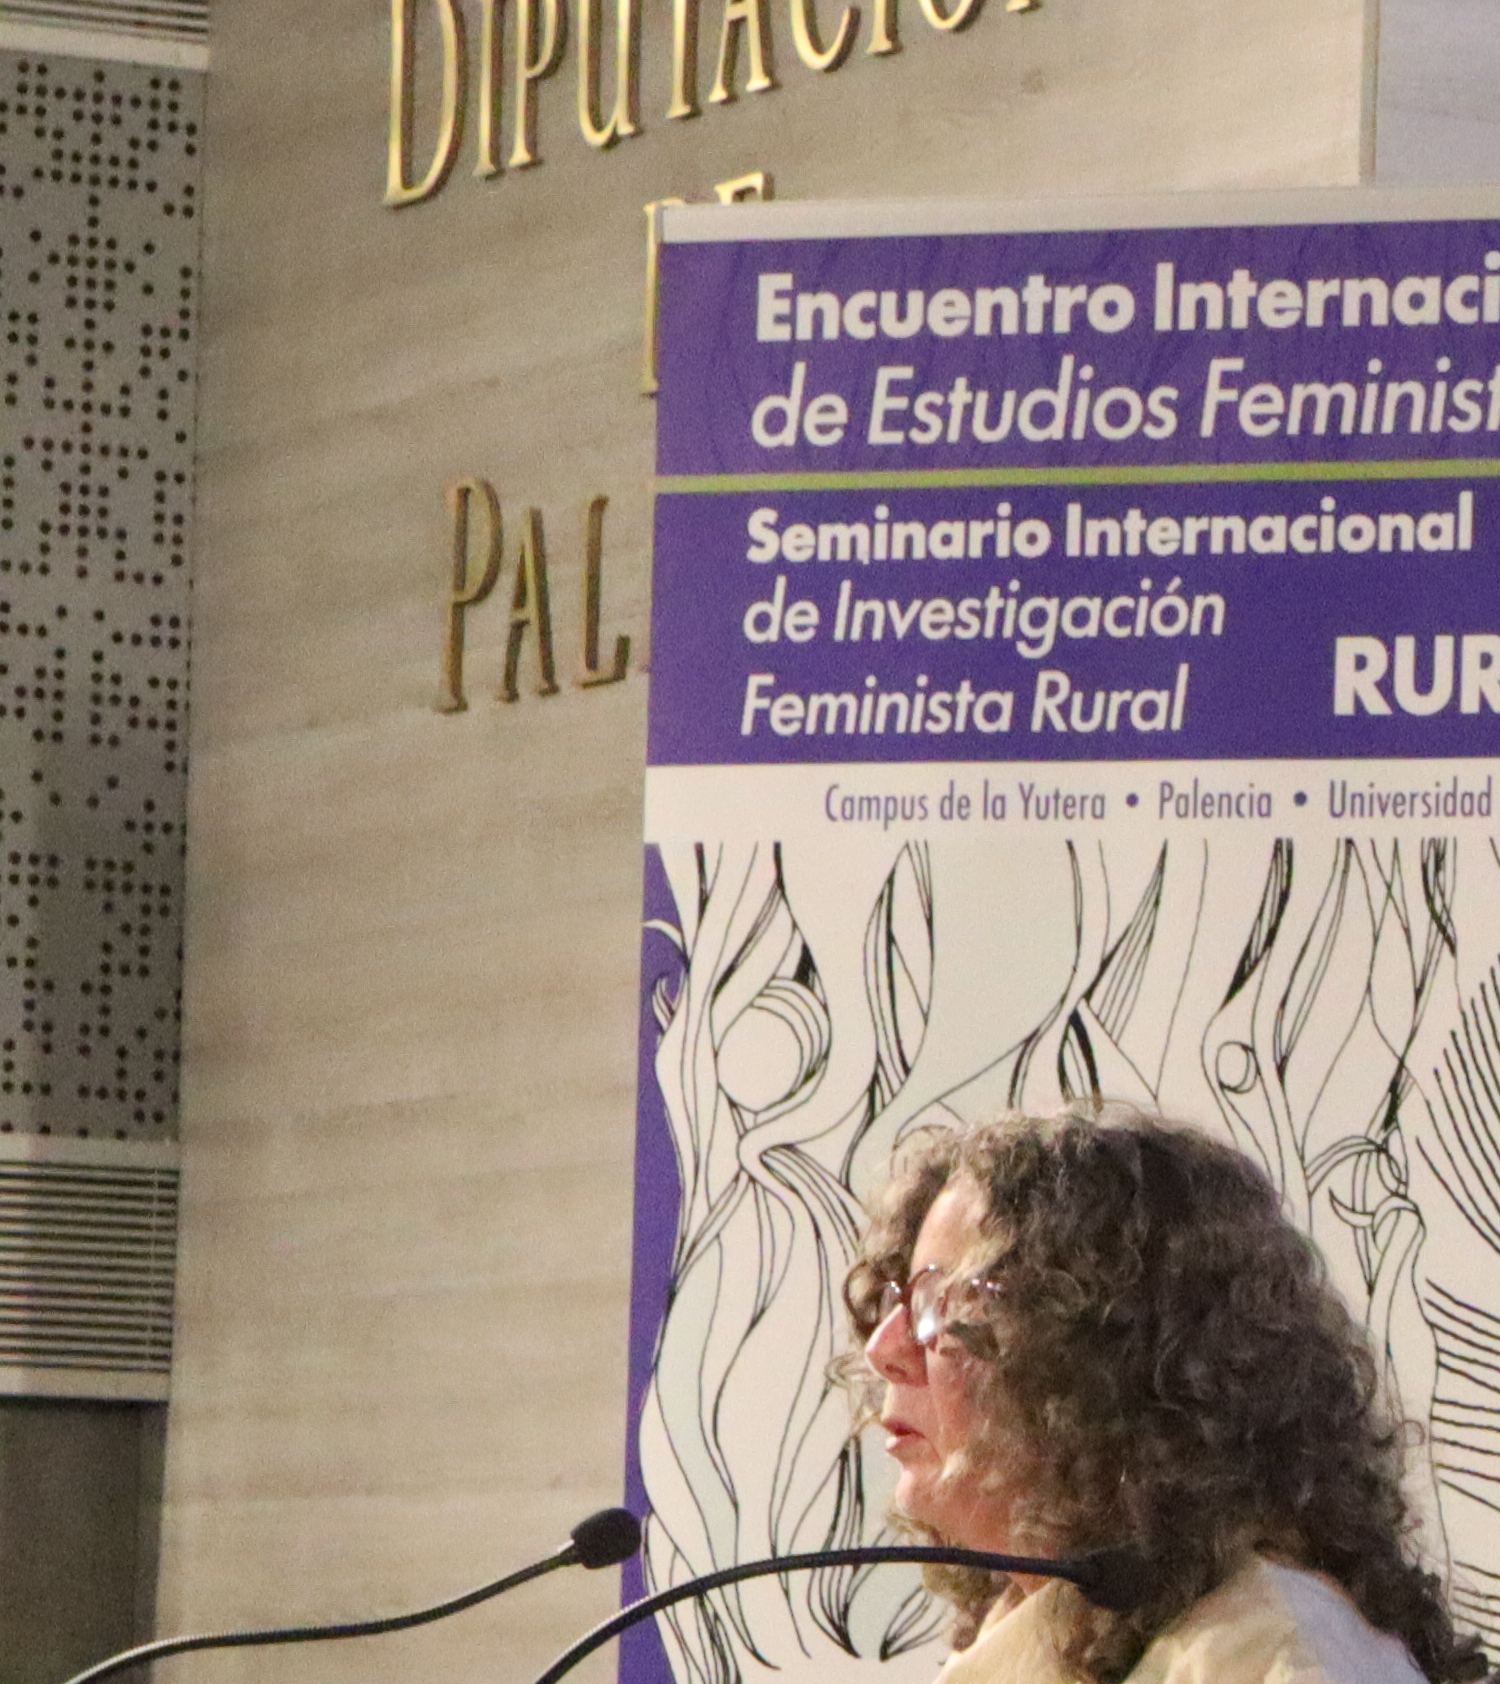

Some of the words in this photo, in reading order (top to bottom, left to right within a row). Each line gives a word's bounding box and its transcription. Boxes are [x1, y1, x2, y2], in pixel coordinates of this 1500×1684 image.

[384, 0, 1036, 207] DIPUTA
[756, 272, 1135, 342] Encuentro
[751, 361, 848, 449] de
[867, 354, 1179, 446] Estudios
[746, 502, 1052, 565] Seminario
[1065, 490, 1473, 557] Internacional
[434, 476, 634, 714] PAL
[742, 575, 820, 644] de
[832, 576, 1225, 660] Investigación
[740, 673, 1014, 737] Feminista
[1030, 662, 1189, 733] Rural
[824, 783, 929, 832] Campus
[938, 779, 972, 822] de
[982, 778, 1007, 822] la
[1017, 781, 1106, 821] Yutera
[1158, 776, 1273, 820] Palencia
[1328, 774, 1493, 820] Universidad
